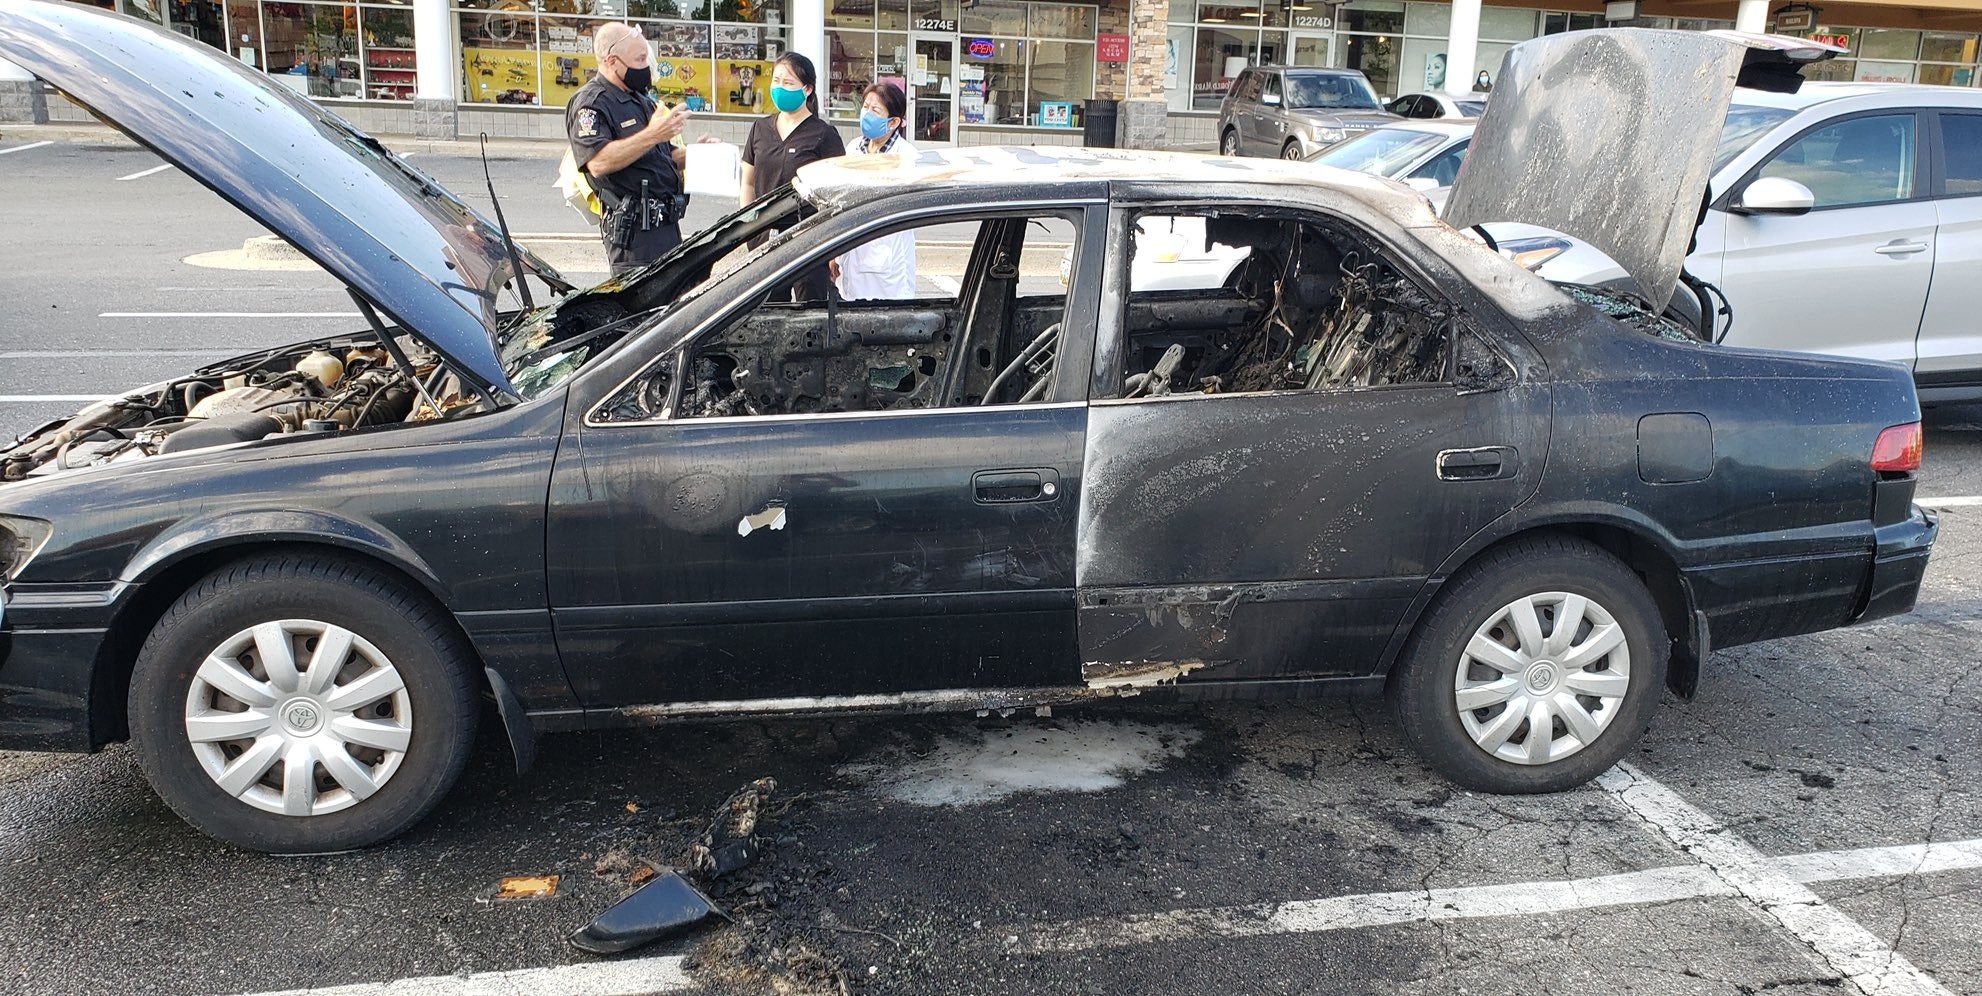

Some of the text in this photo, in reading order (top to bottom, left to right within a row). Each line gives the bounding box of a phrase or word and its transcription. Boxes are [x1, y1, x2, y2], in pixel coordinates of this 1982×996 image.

[915, 19, 954, 30] 12274E
[1295, 16, 1331, 27] 12274D
[970, 43, 994, 53] OPEN
